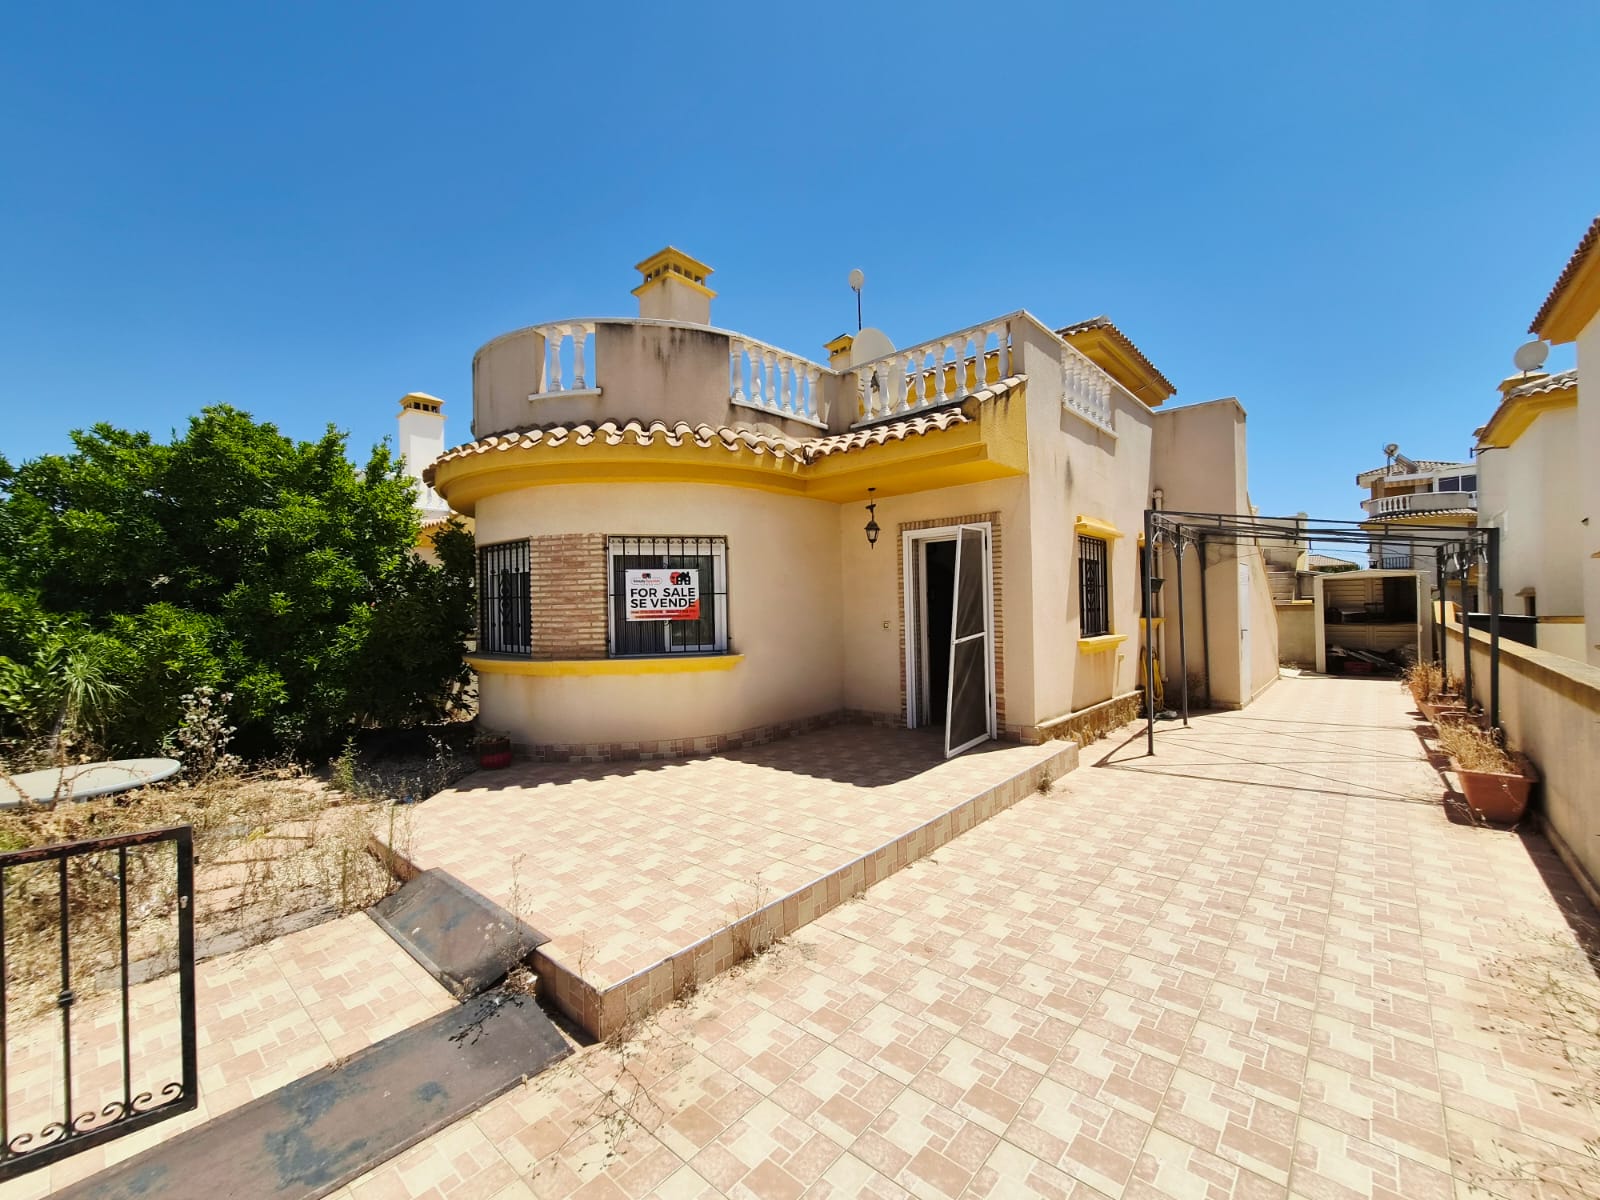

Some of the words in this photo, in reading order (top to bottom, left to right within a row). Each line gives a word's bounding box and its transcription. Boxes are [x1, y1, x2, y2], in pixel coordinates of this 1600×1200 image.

[631, 588, 657, 598] FOR
[663, 587, 695, 597] SALE
[631, 599, 646, 608] SE
[650, 598, 695, 608] VENDE
